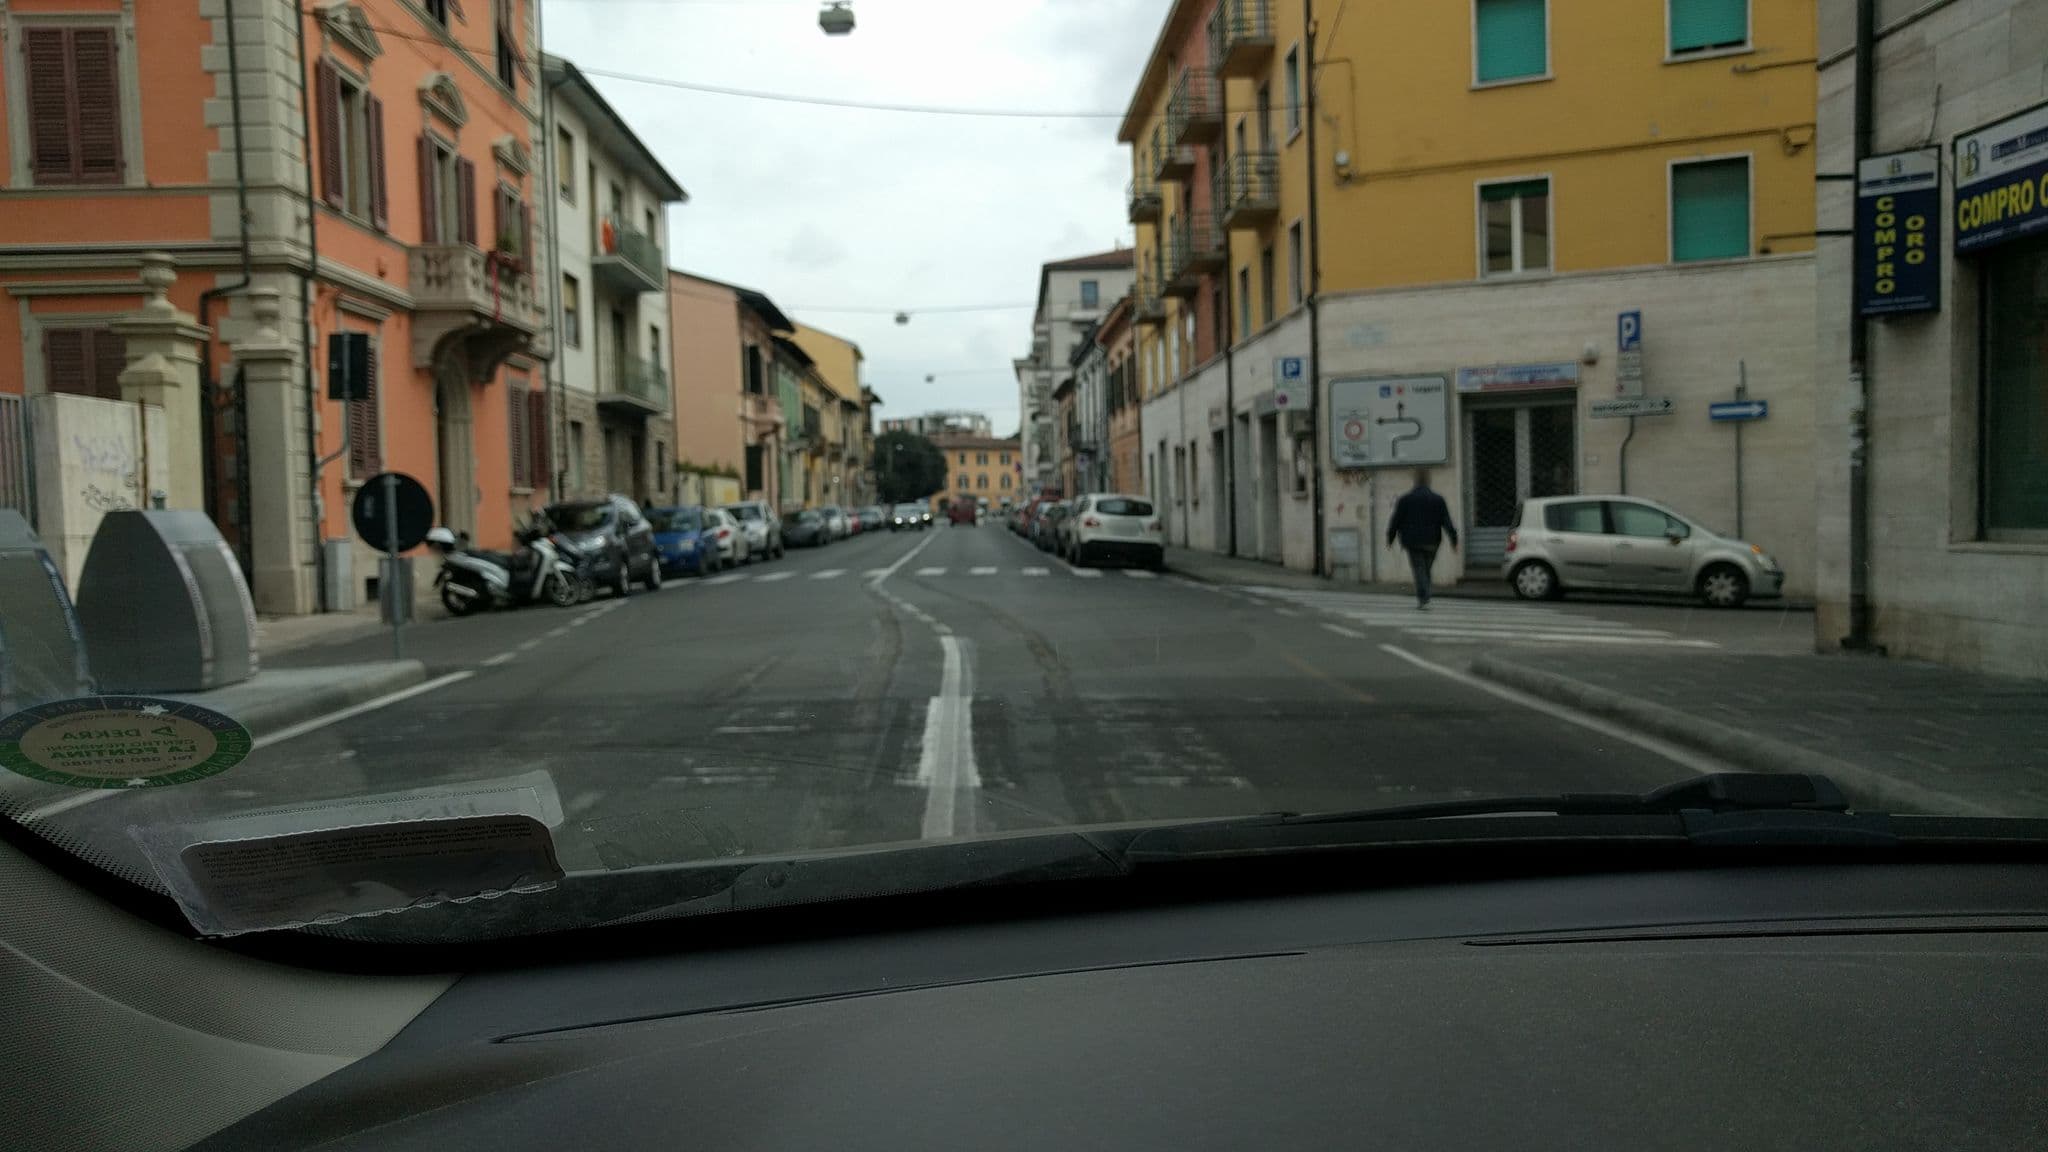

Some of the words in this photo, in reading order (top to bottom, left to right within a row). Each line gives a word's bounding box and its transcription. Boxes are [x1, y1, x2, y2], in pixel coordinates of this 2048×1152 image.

[1958, 181, 2034, 231] COMPRO
[1874, 197, 1897, 294] COMPRO
[1905, 215, 1925, 265] ORO
